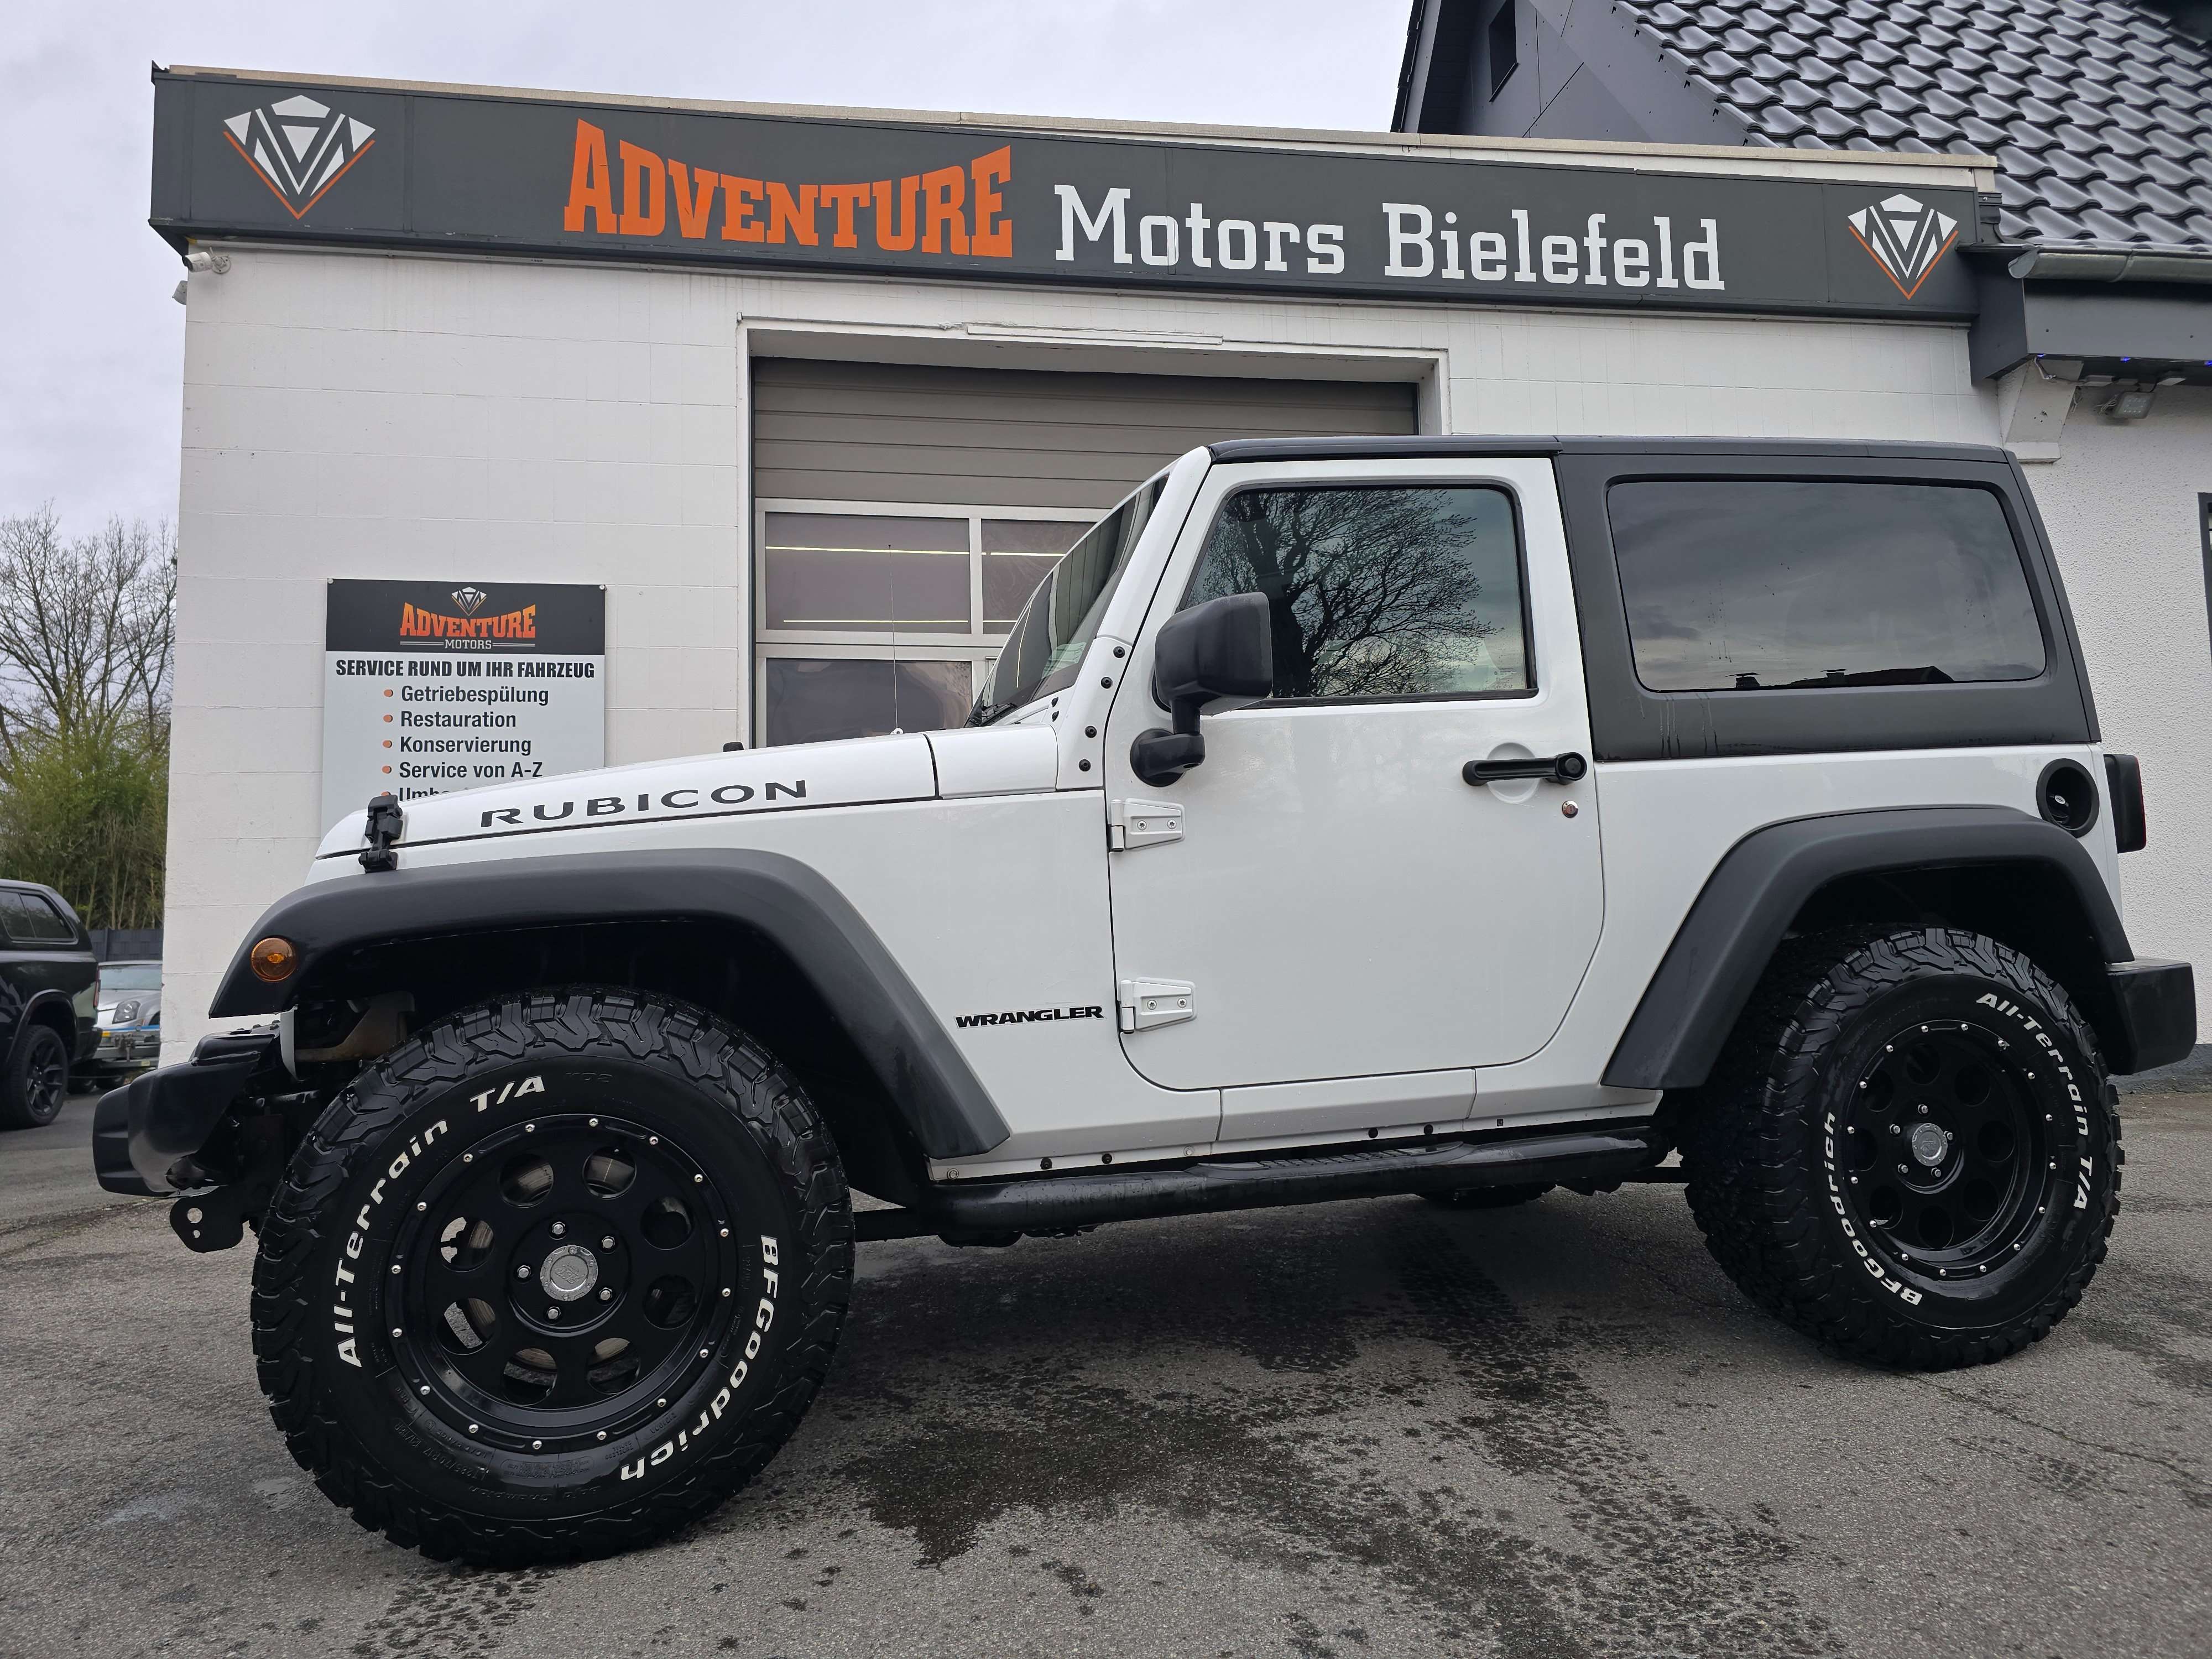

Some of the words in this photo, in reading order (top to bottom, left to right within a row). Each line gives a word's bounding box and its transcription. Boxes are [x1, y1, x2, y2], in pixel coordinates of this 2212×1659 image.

[564, 118, 1013, 258] ADVENTURE
[1054, 184, 1345, 274] Motors
[1382, 202, 1725, 290] Bielefeld
[400, 602, 536, 638] ADVENTURE
[445, 639, 492, 649] MOTORS
[336, 659, 404, 676] SERVICE
[408, 660, 452, 676] RUND
[456, 661, 482, 677] UM
[486, 661, 513, 677] IHR
[518, 662, 595, 678] FAHRZEUG
[401, 685, 549, 706] Getriebespülung
[401, 711, 516, 727] Restauration
[400, 736, 531, 756] Konservierung
[399, 761, 467, 778] Service
[473, 765, 505, 778] von
[510, 761, 543, 778] A-Z
[481, 780, 806, 828] RUBICON
[955, 1006, 1104, 1028] WRANGLER
[1976, 993, 2089, 1136] All-Terrain
[2074, 1156, 2093, 1209] T/A
[333, 1119, 450, 1368] All-Terrain
[469, 1077, 545, 1112] T/A
[1824, 1112, 1923, 1306] BFGoodrich
[620, 1234, 779, 1481] BFGoodrich
